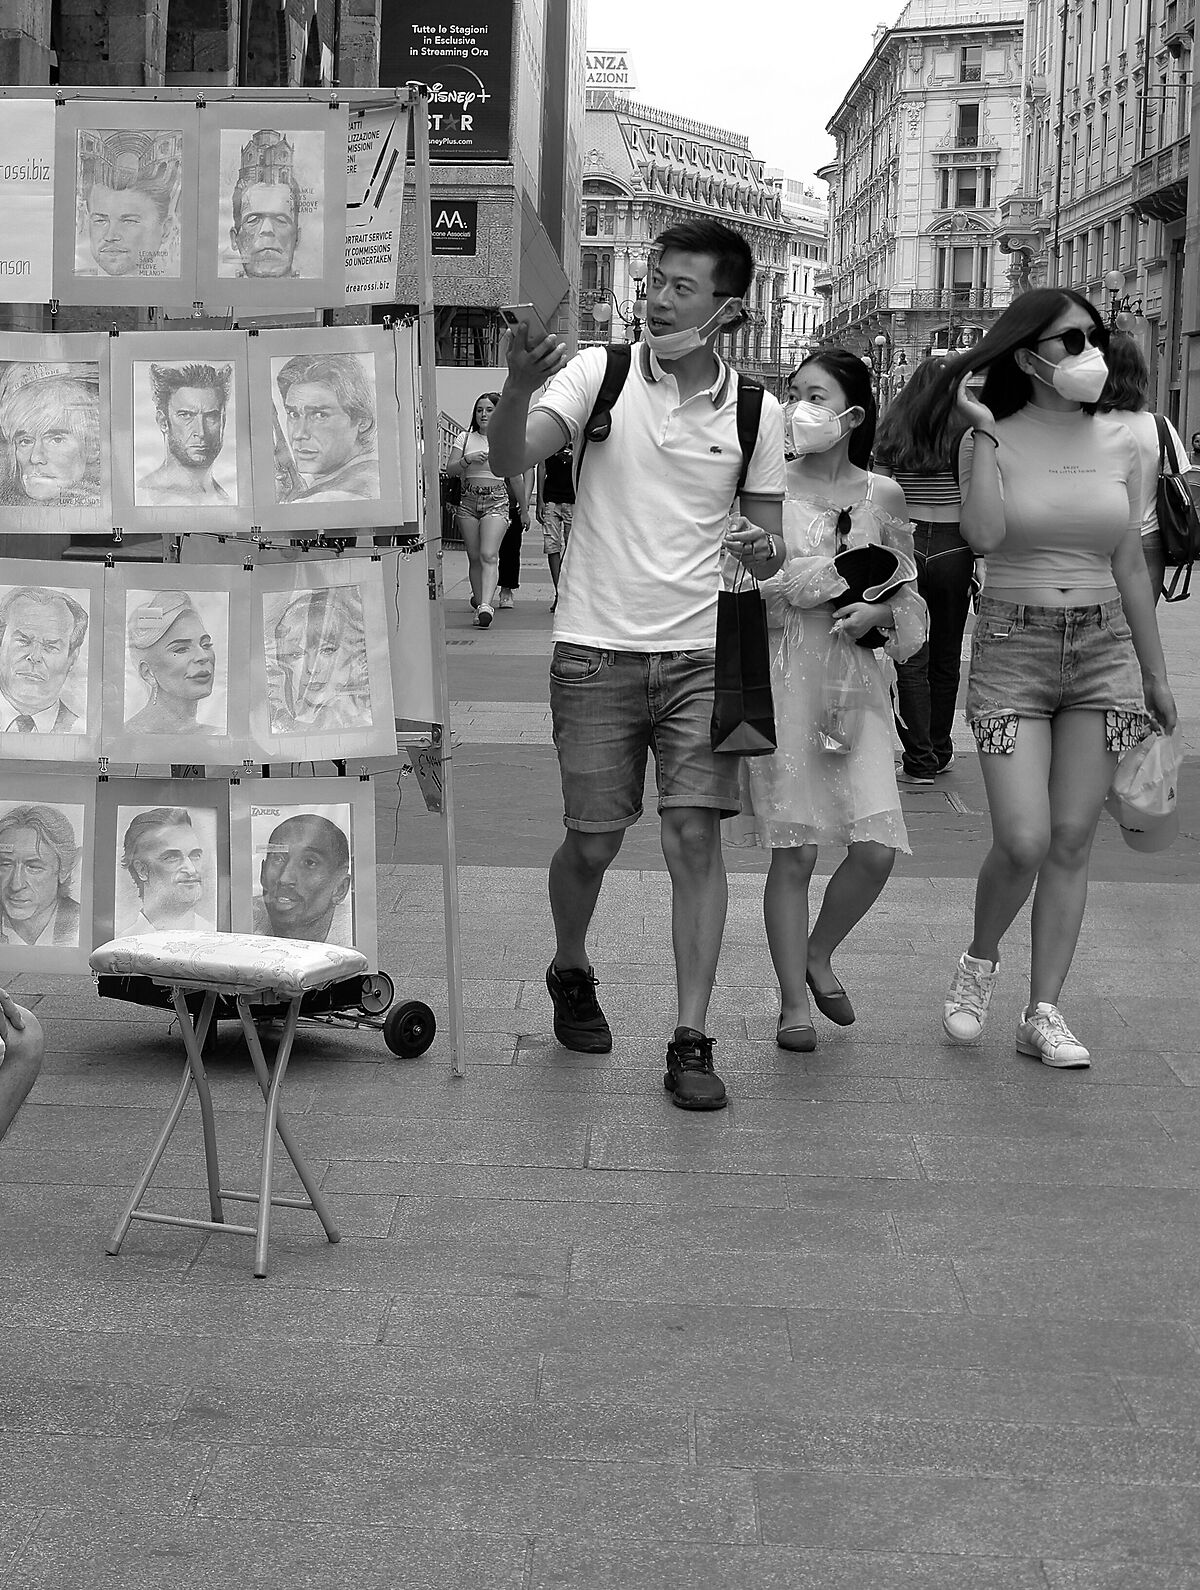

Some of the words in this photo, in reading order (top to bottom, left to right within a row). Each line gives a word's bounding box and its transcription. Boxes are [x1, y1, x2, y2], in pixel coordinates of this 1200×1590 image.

[412, 24, 436, 34] Tutte
[438, 24, 448, 34] le
[449, 24, 488, 36] Stagioni
[423, 36, 432, 45] in
[435, 35, 476, 45] Esclusiva
[409, 47, 419, 56] in
[420, 47, 469, 58] Streaming
[471, 47, 489, 56] Ora
[586, 56, 629, 70] ANZA
[586, 72, 628, 83] AZIONI
[349, 121, 362, 130] ATTI
[348, 130, 380, 143] LIZZAZIONE
[348, 142, 373, 153] MISSIONI
[369, 230, 393, 242] SERVICE
[352, 243, 391, 257] COMMISSIONS
[354, 254, 392, 266] UNDERTAKEN
[346, 280, 390, 293] drearossi.biz
